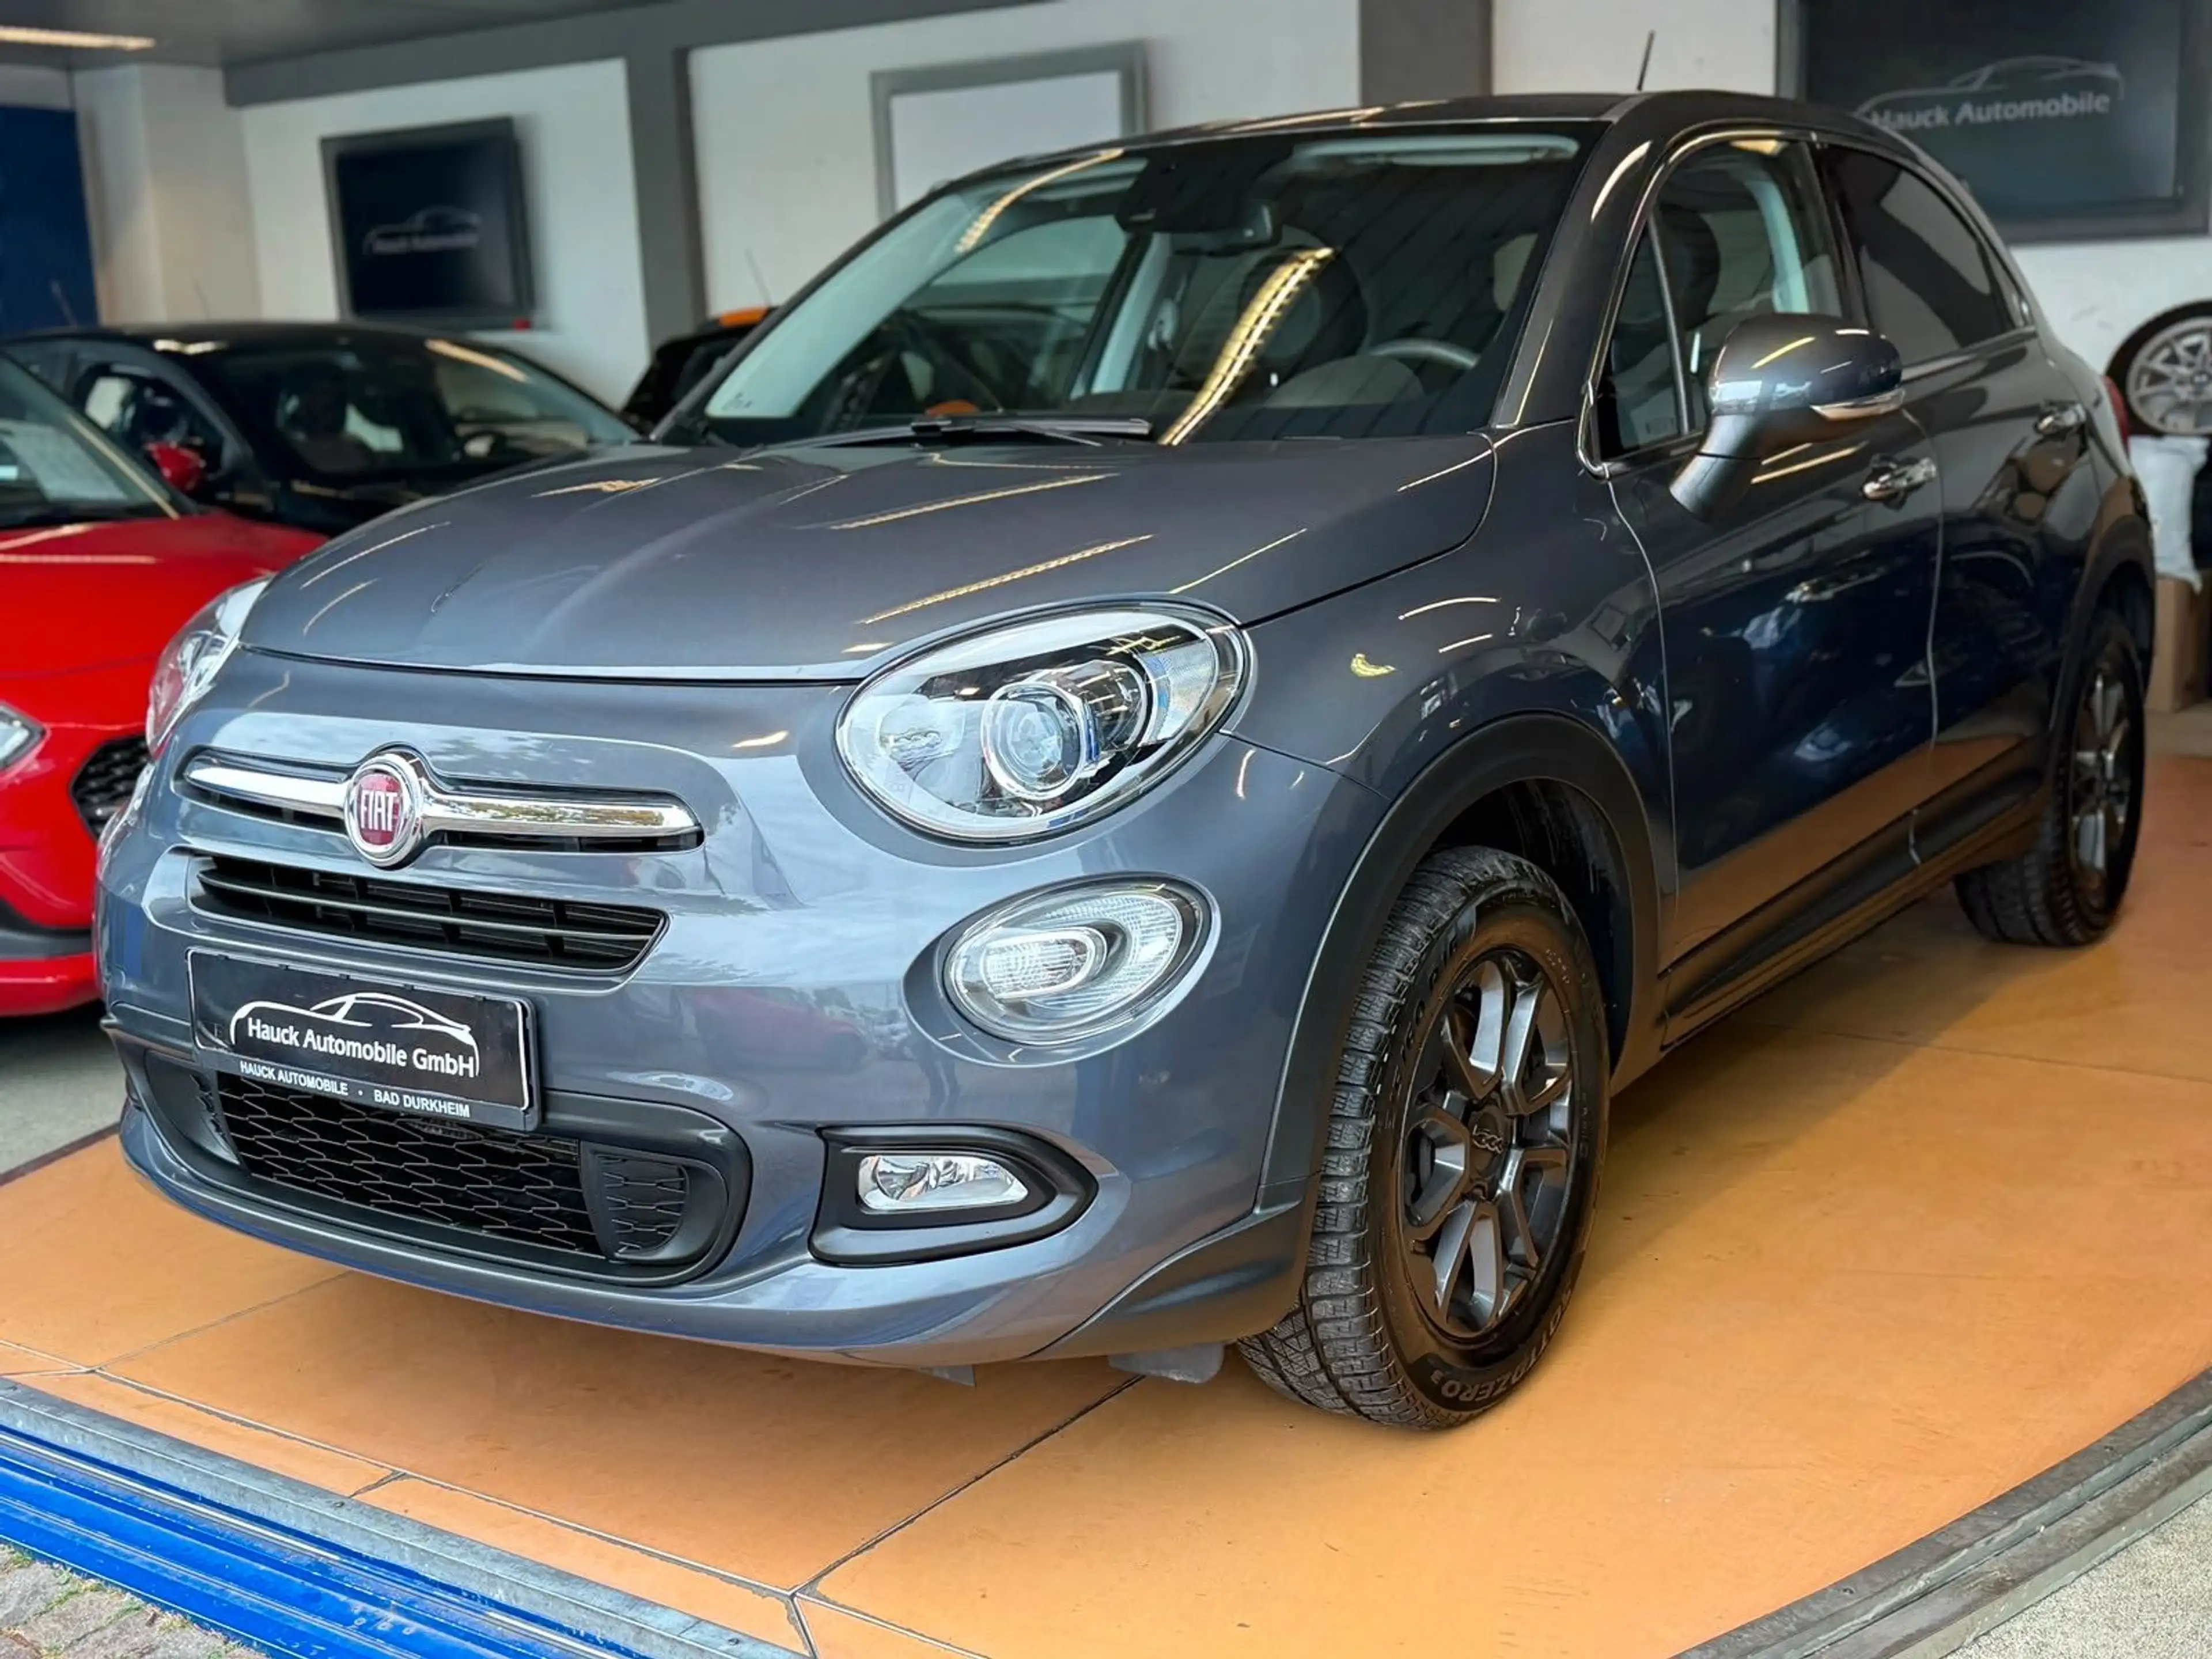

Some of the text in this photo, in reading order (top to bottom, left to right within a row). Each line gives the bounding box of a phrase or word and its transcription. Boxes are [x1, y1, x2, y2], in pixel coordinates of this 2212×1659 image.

[1872, 90, 2110, 130] Hauck Automobile
[361, 789, 397, 832] FIAT
[247, 1017, 475, 1078] Hauck Automobile GmbH
[240, 1060, 470, 1118] HAUCK AUTOMOBILE BAD DURKHEIM
